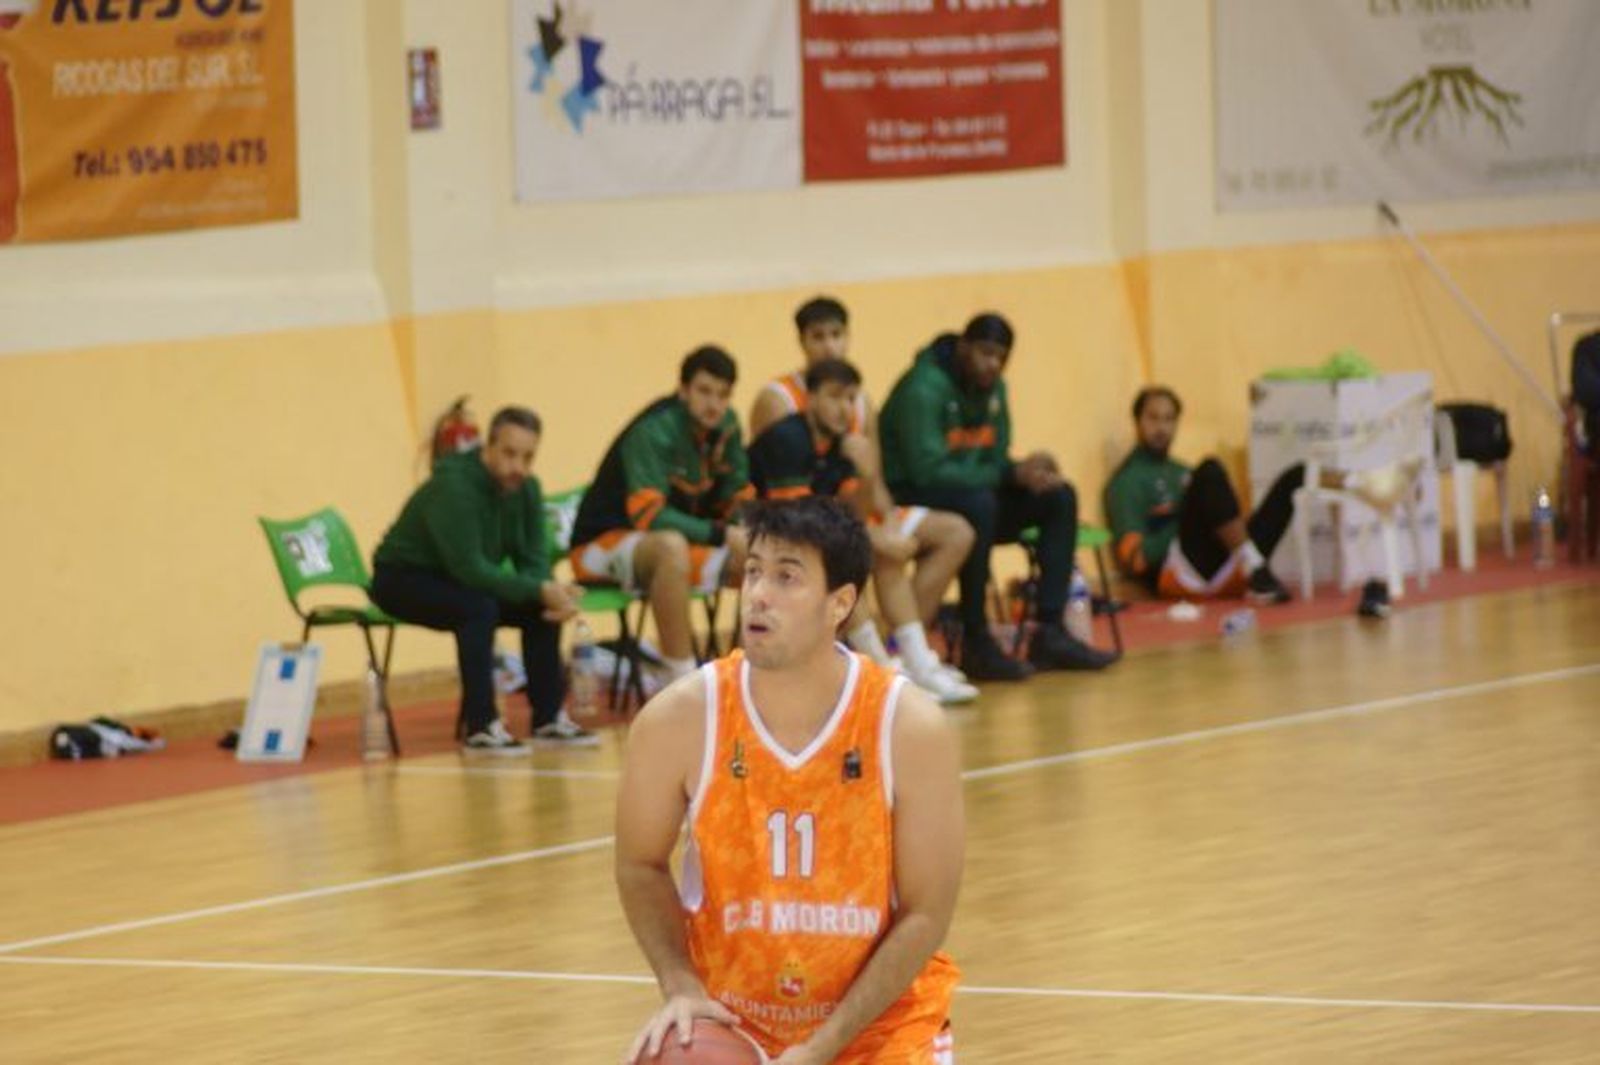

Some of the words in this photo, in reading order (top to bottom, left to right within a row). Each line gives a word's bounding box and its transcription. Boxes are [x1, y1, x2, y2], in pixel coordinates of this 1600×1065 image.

[127, 144, 175, 175] 954
[766, 809, 816, 879] 11
[769, 895, 882, 938] MORÓN
